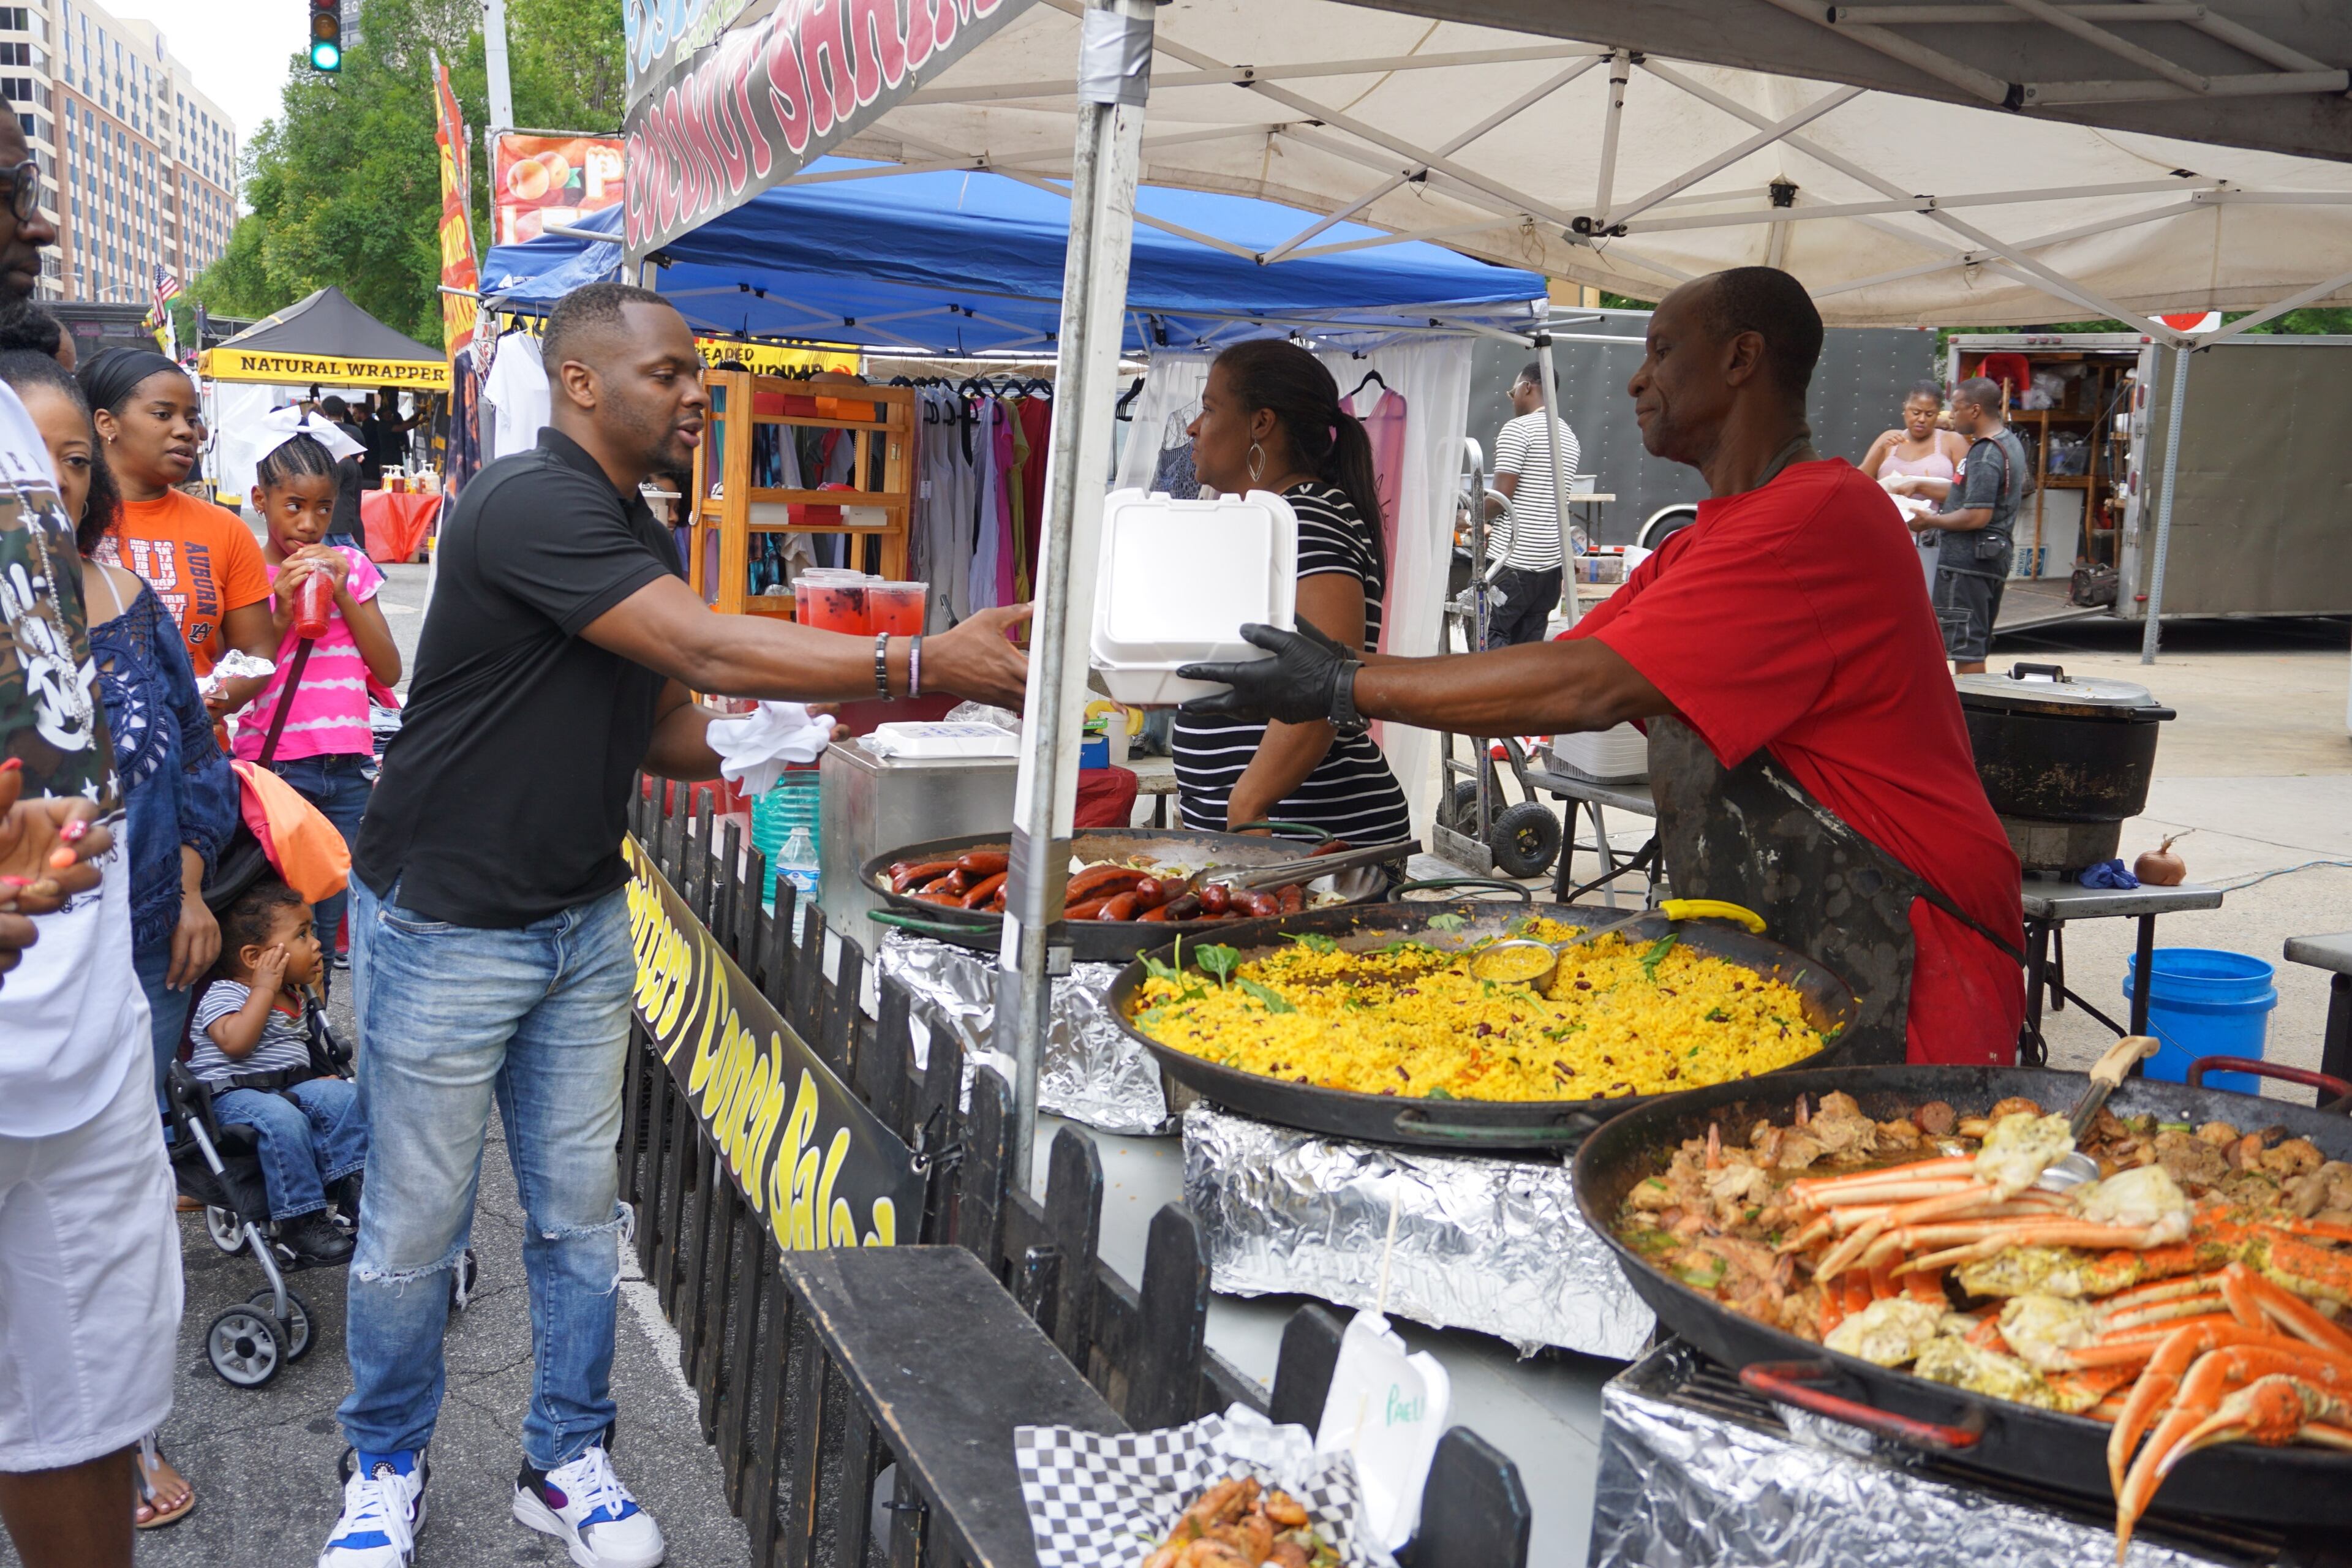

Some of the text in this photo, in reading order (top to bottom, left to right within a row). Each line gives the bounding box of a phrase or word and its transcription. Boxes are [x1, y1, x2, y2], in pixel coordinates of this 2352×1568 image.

[625, 24, 772, 252] COCONUT
[241, 356, 445, 381] NATURAL WRAPPER
[184, 541, 217, 616] AUBURN
[2016, 549, 2026, 576] PARKING
[688, 947, 786, 1213] Conch
